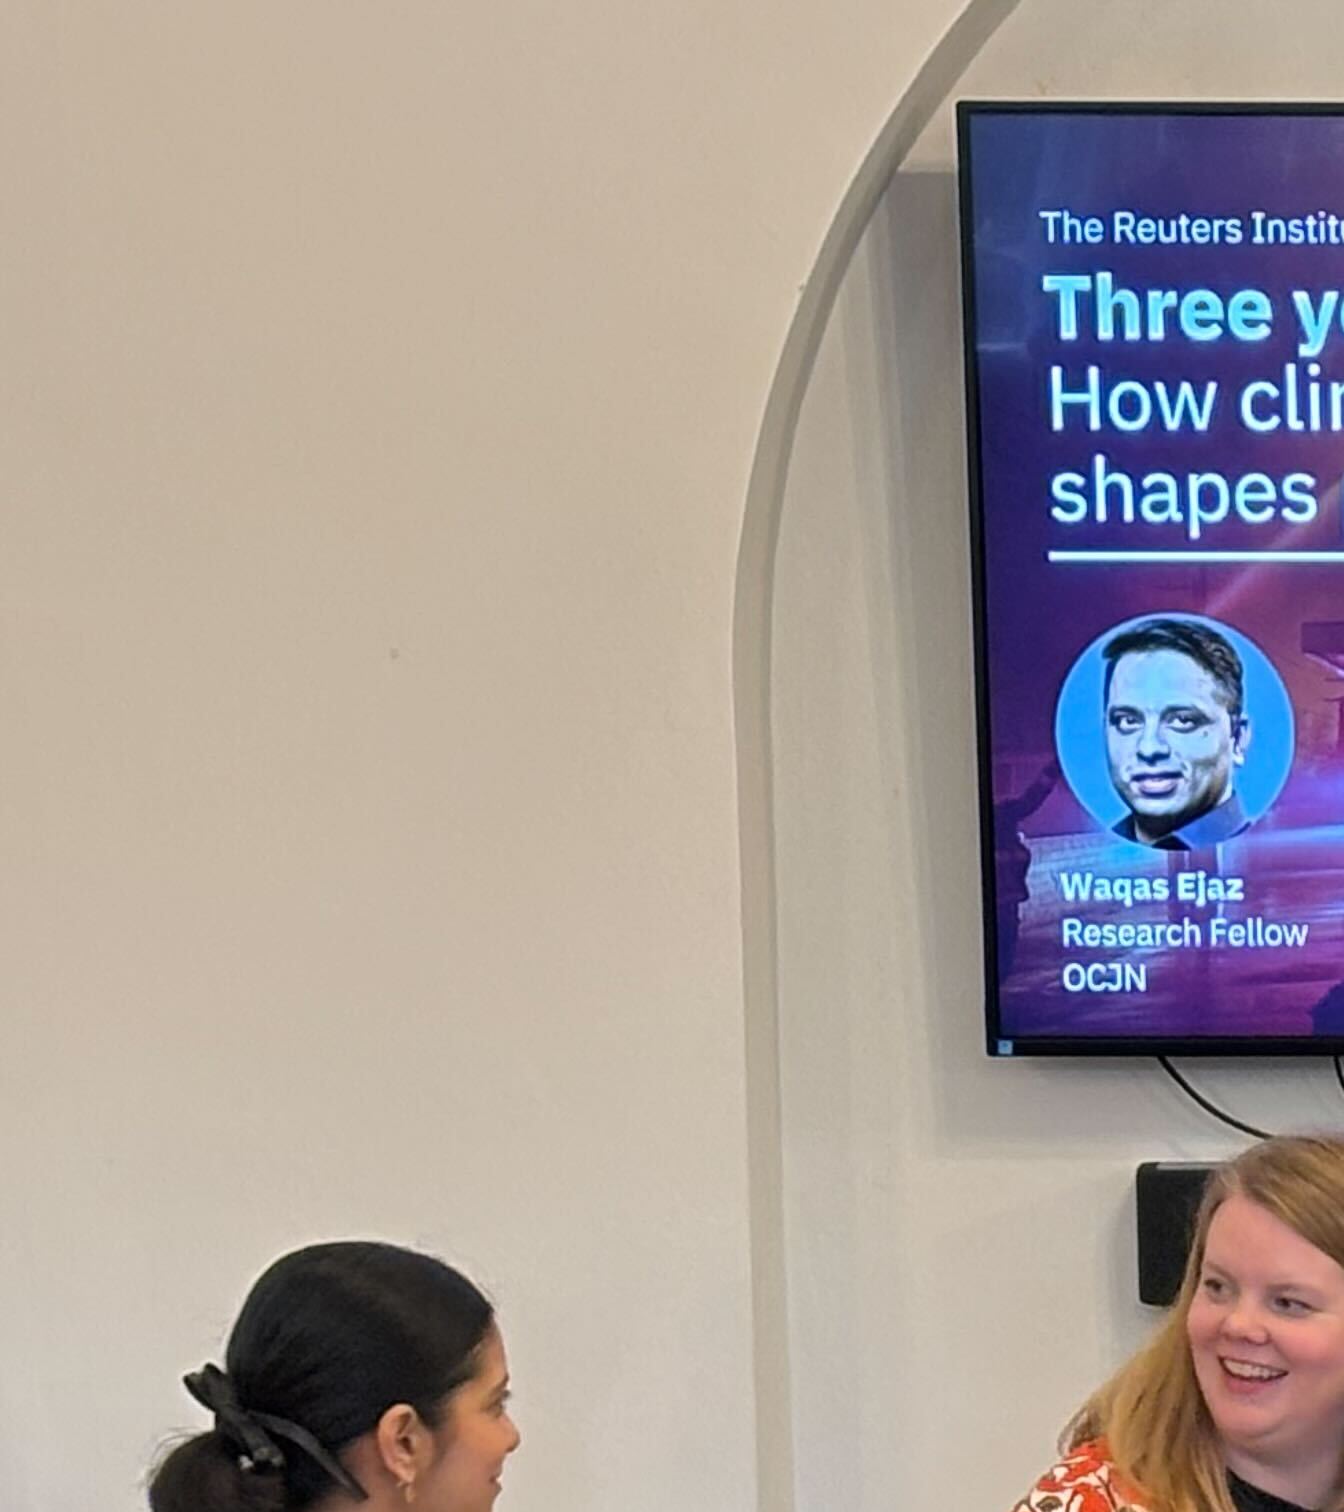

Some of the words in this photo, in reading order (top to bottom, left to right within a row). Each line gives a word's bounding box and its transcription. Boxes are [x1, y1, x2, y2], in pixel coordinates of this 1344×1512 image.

[1040, 211, 1104, 243] The
[1114, 211, 1242, 243] Reuters
[1042, 272, 1273, 341] Three
[1050, 363, 1218, 432] How
[1050, 454, 1318, 539] shapes
[1060, 872, 1170, 908] Waqas
[1176, 871, 1245, 908] Ejaz
[1062, 918, 1201, 947] Research
[1209, 918, 1309, 947] Fellow
[1062, 962, 1148, 992] OCJN
